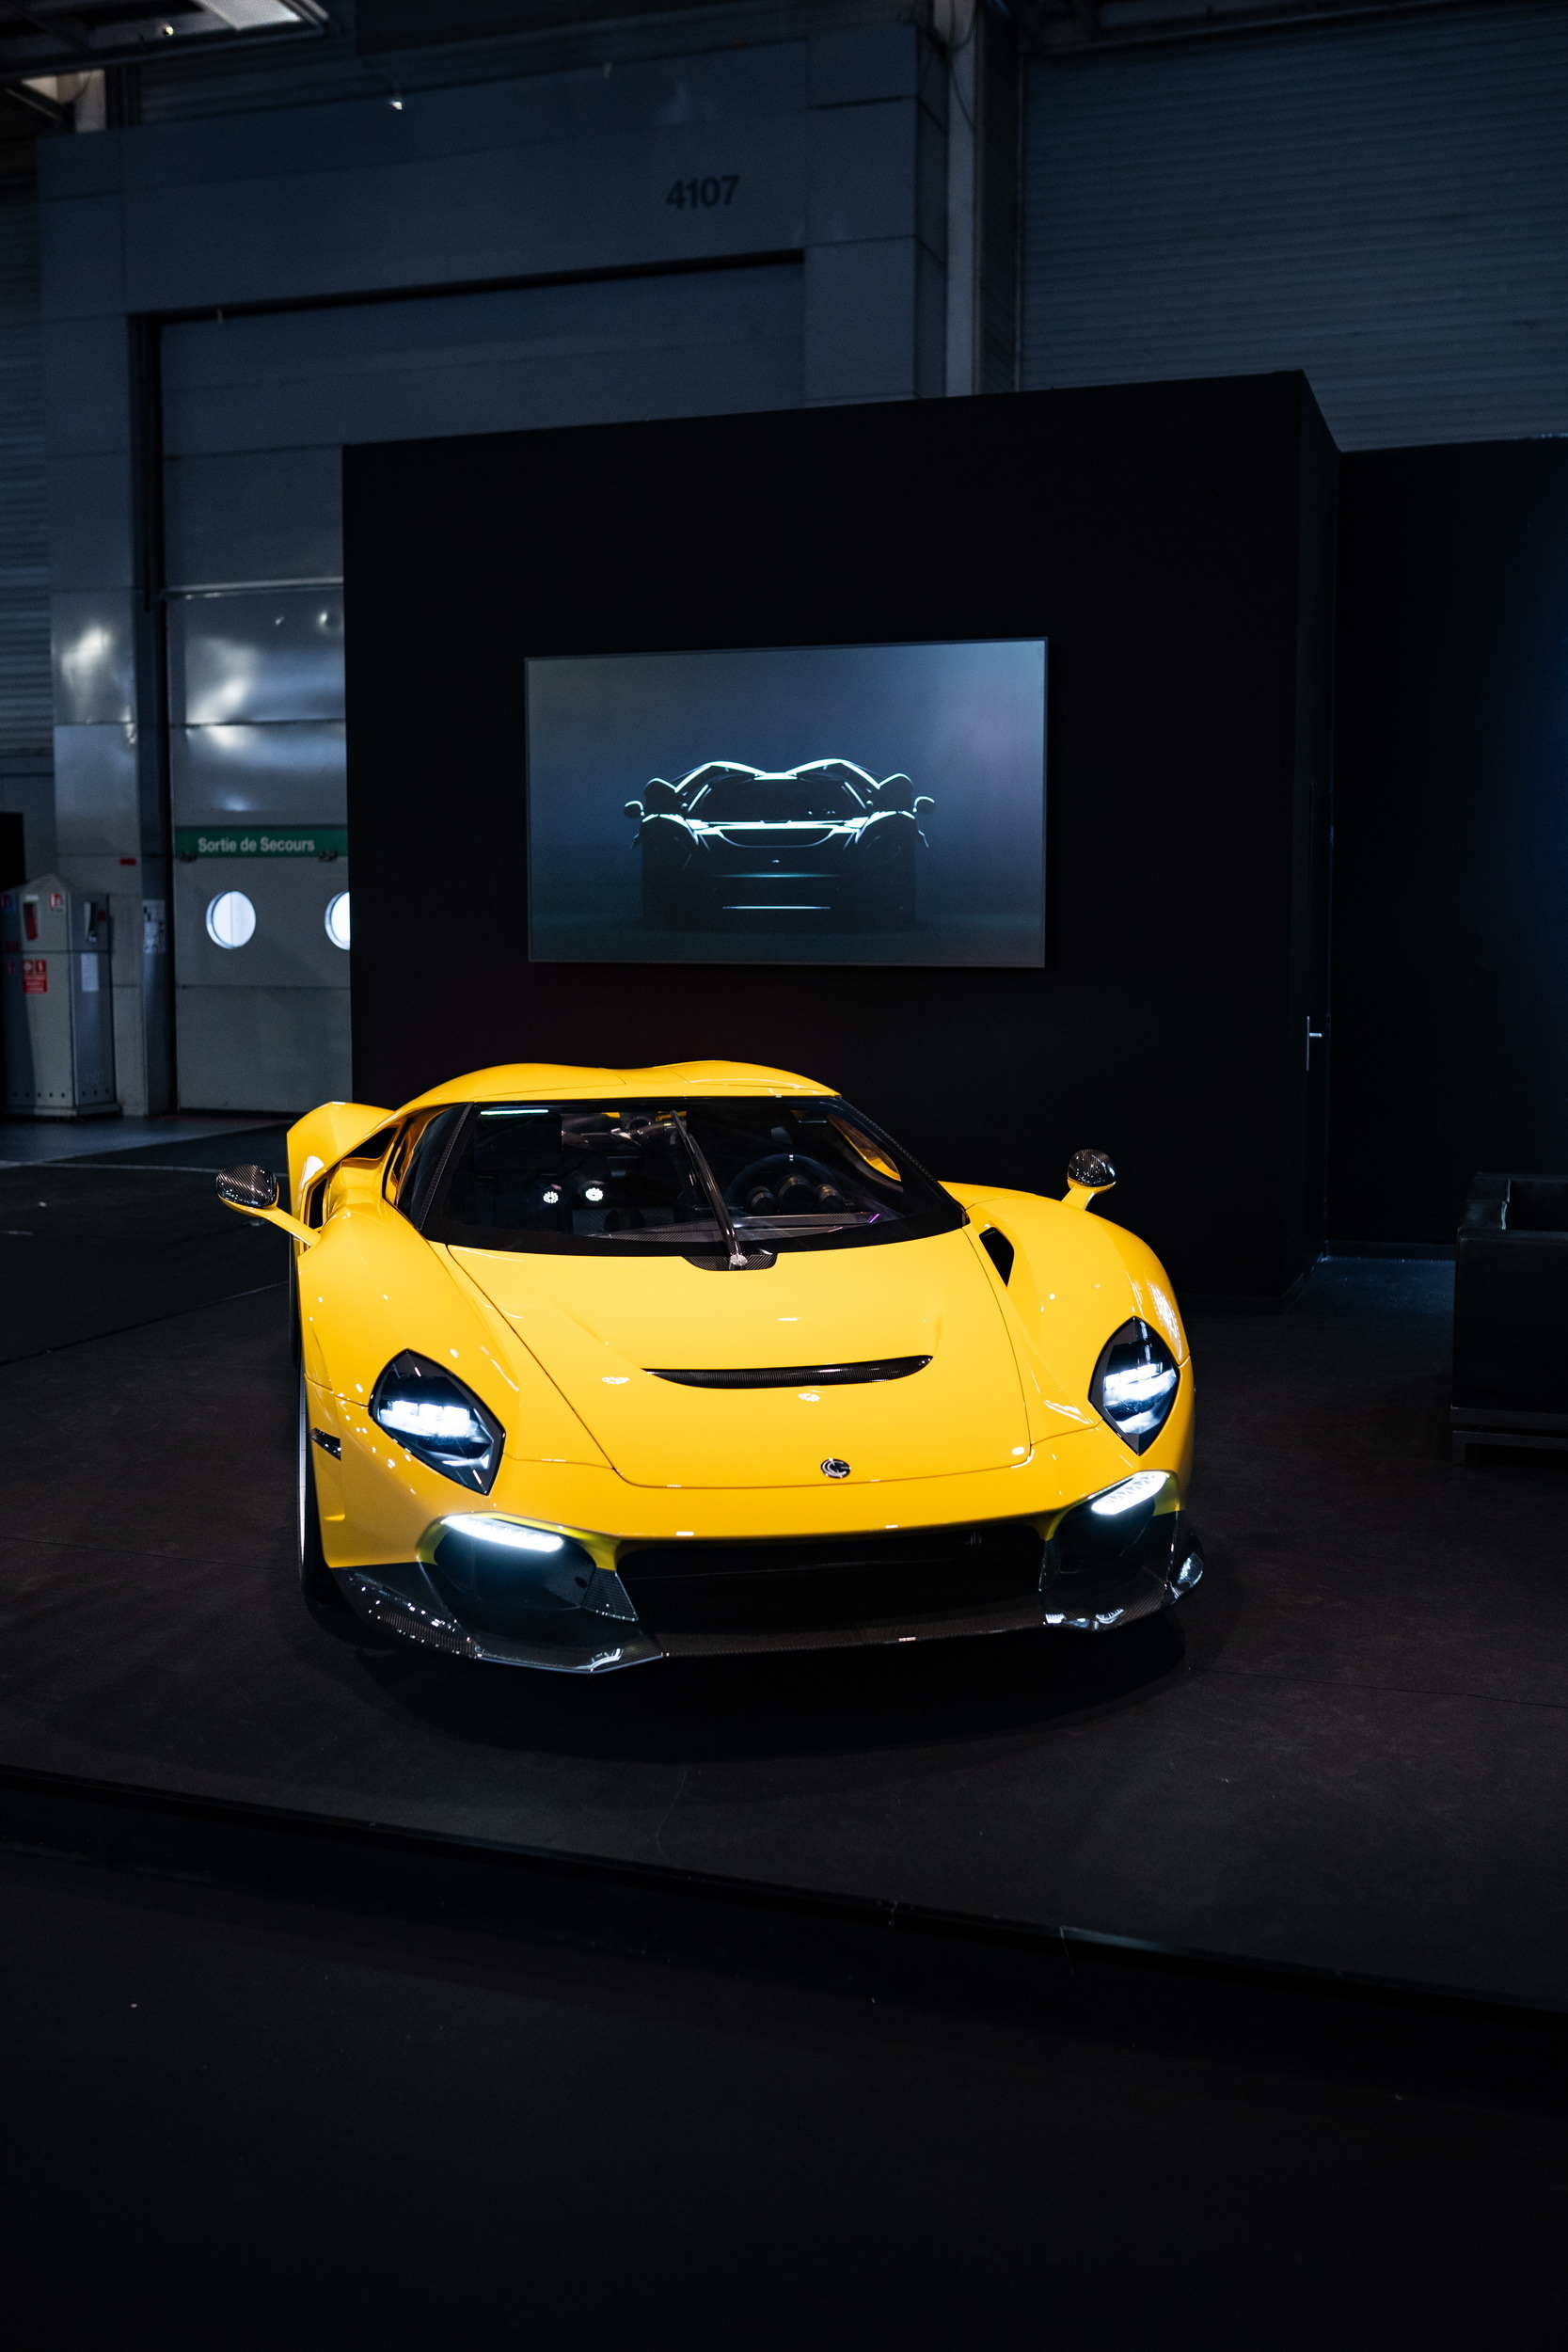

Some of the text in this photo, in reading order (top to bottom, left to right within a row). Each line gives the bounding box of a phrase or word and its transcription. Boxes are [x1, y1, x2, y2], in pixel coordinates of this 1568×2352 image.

[666, 174, 739, 209] 4107
[198, 835, 315, 852] Sortie de Secours
